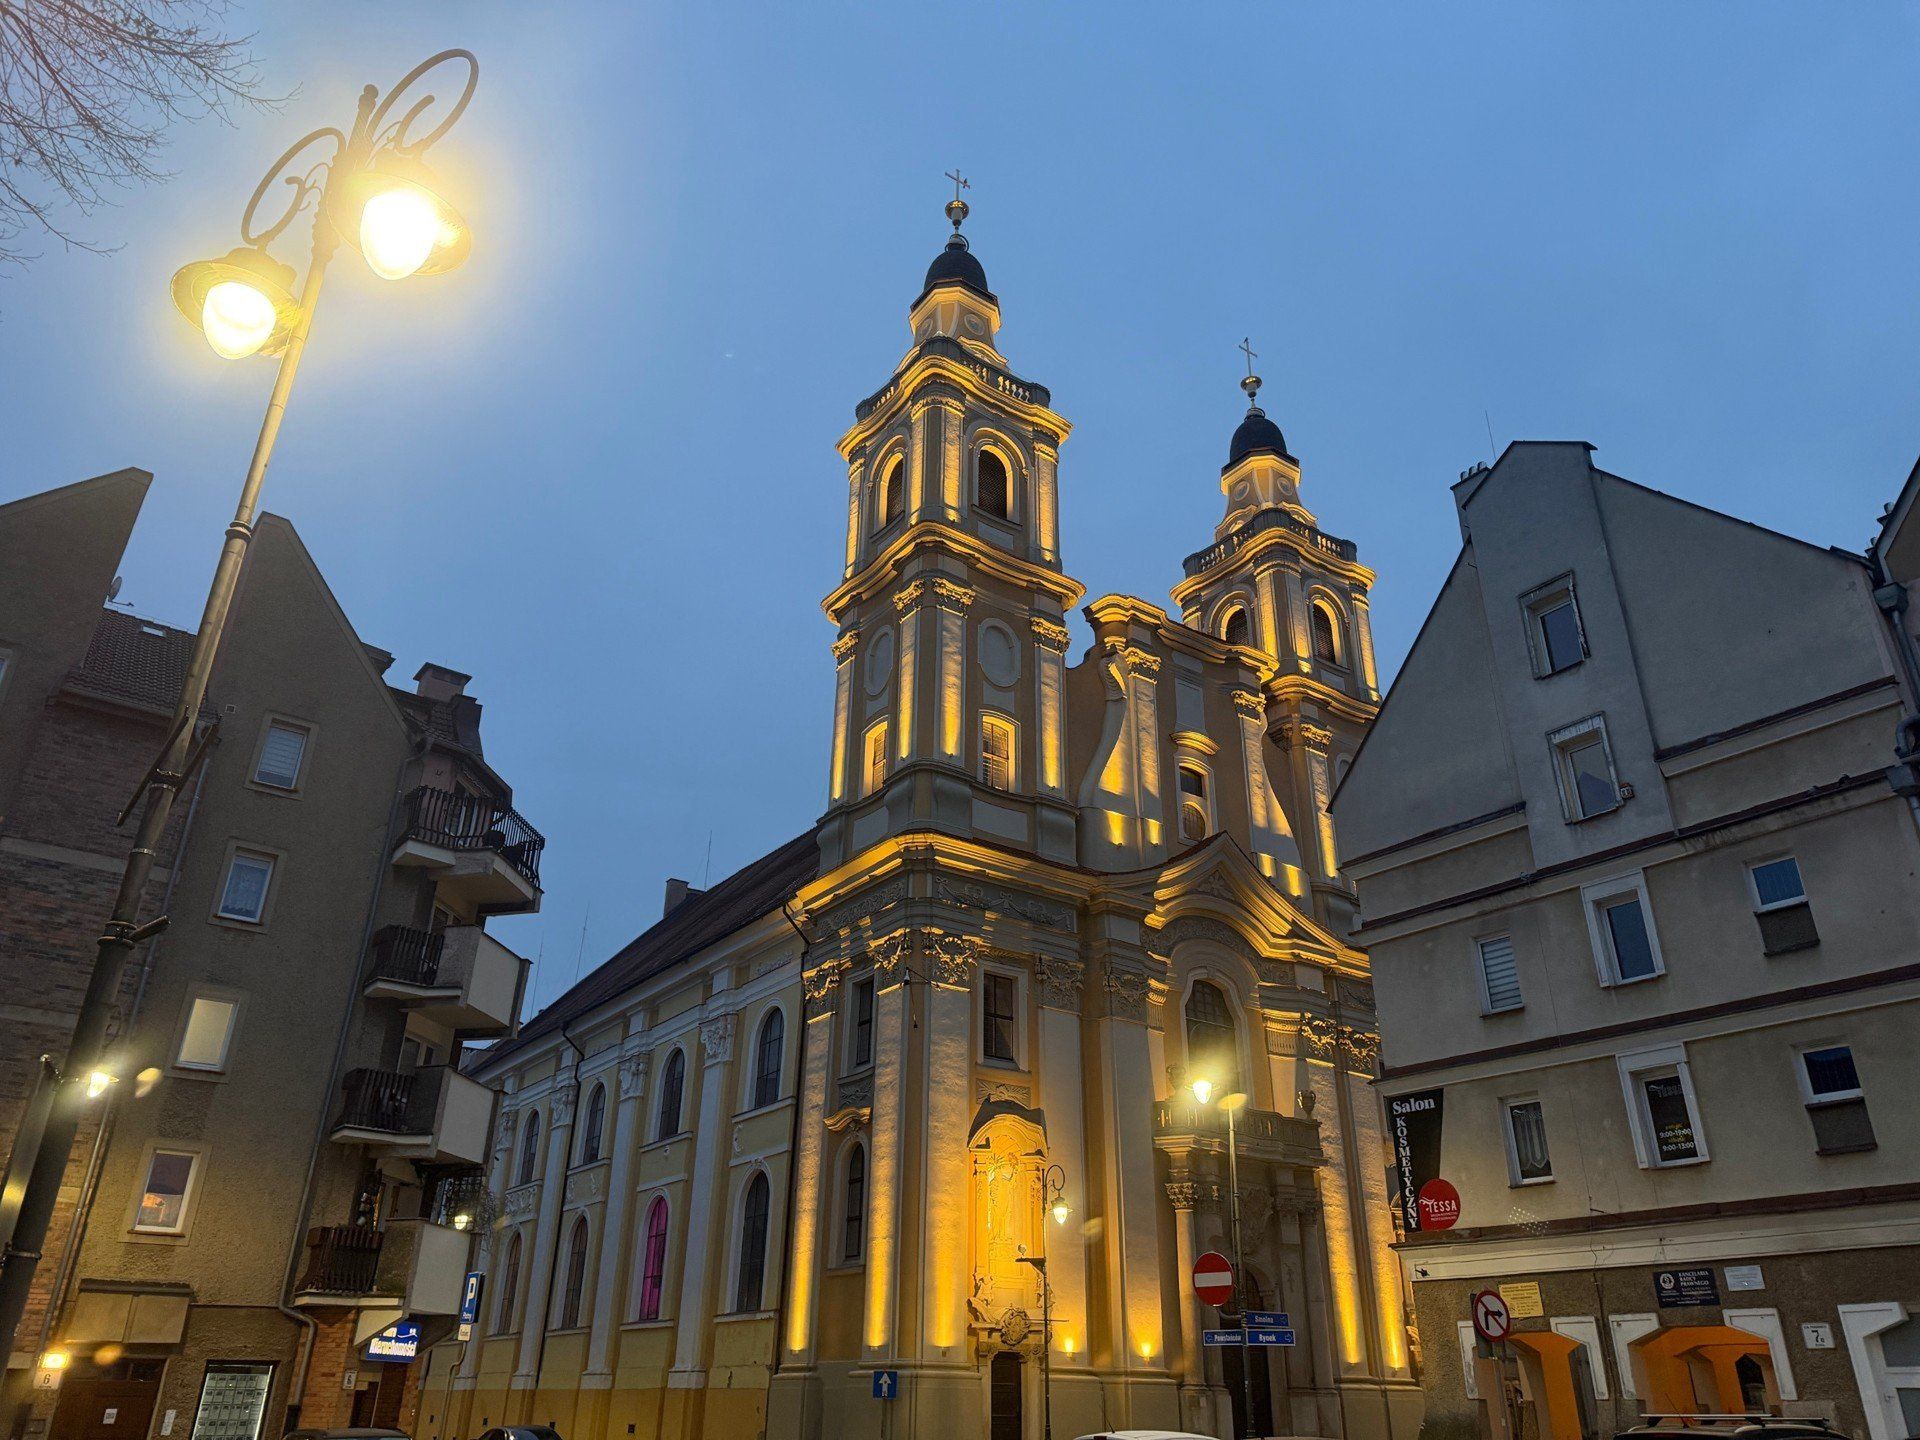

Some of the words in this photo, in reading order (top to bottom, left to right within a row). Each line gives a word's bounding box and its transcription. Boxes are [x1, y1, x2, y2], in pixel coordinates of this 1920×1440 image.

[1392, 1098, 1435, 1115] Salon
[1396, 1116, 1419, 1229] KOSMETYCZNY
[1420, 1197, 1458, 1213] TESSA
[465, 1277, 477, 1308] P
[1254, 1315, 1274, 1323] Smolna
[1258, 1334, 1277, 1342] Rynek
[43, 1373, 51, 1385] 6
